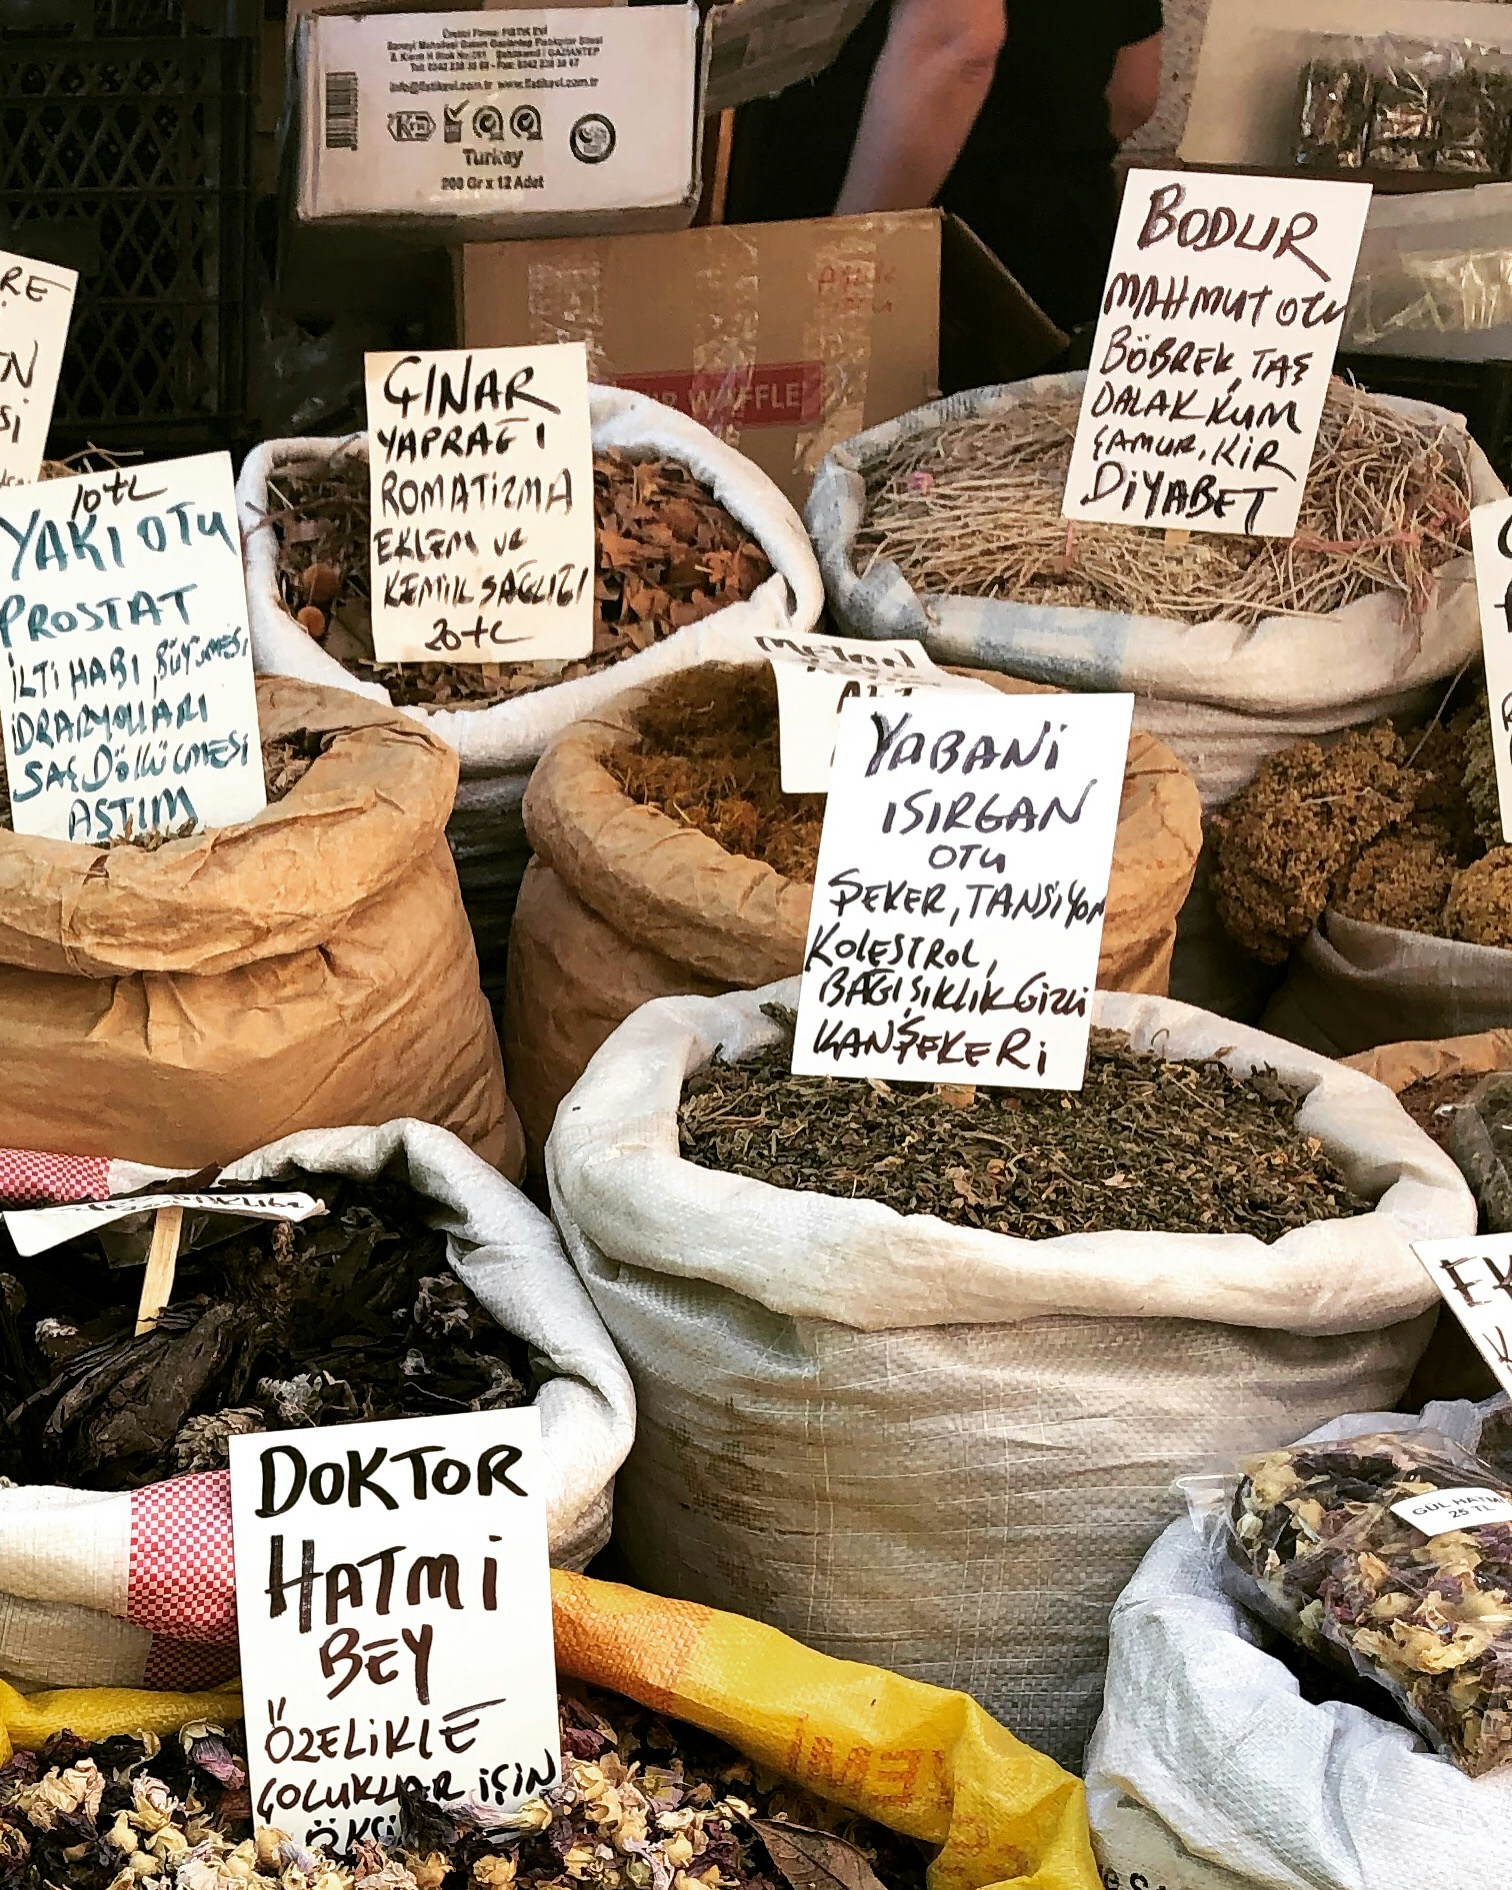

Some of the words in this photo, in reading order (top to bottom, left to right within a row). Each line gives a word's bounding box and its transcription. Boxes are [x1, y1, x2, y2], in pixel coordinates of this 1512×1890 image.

[1137, 182, 1332, 283] BODUR
[1103, 271, 1272, 327] MAHMUT
[383, 355, 561, 420] ÇINAR
[1091, 380, 1207, 422] DALAK
[1080, 460, 1279, 537] DİYABET
[136, 502, 237, 556] OTU
[373, 526, 480, 566] EKLEM
[864, 711, 1068, 778] YABANİ
[67, 785, 199, 841] ASTIM
[881, 778, 1098, 835] ISIRGAN
[928, 843, 1007, 873] OTU
[255, 1444, 529, 1519] DOKTOR
[1448, 1508, 1470, 1518] 25
[264, 1535, 503, 1634] HATMİ
[319, 1623, 433, 1706] BEY
